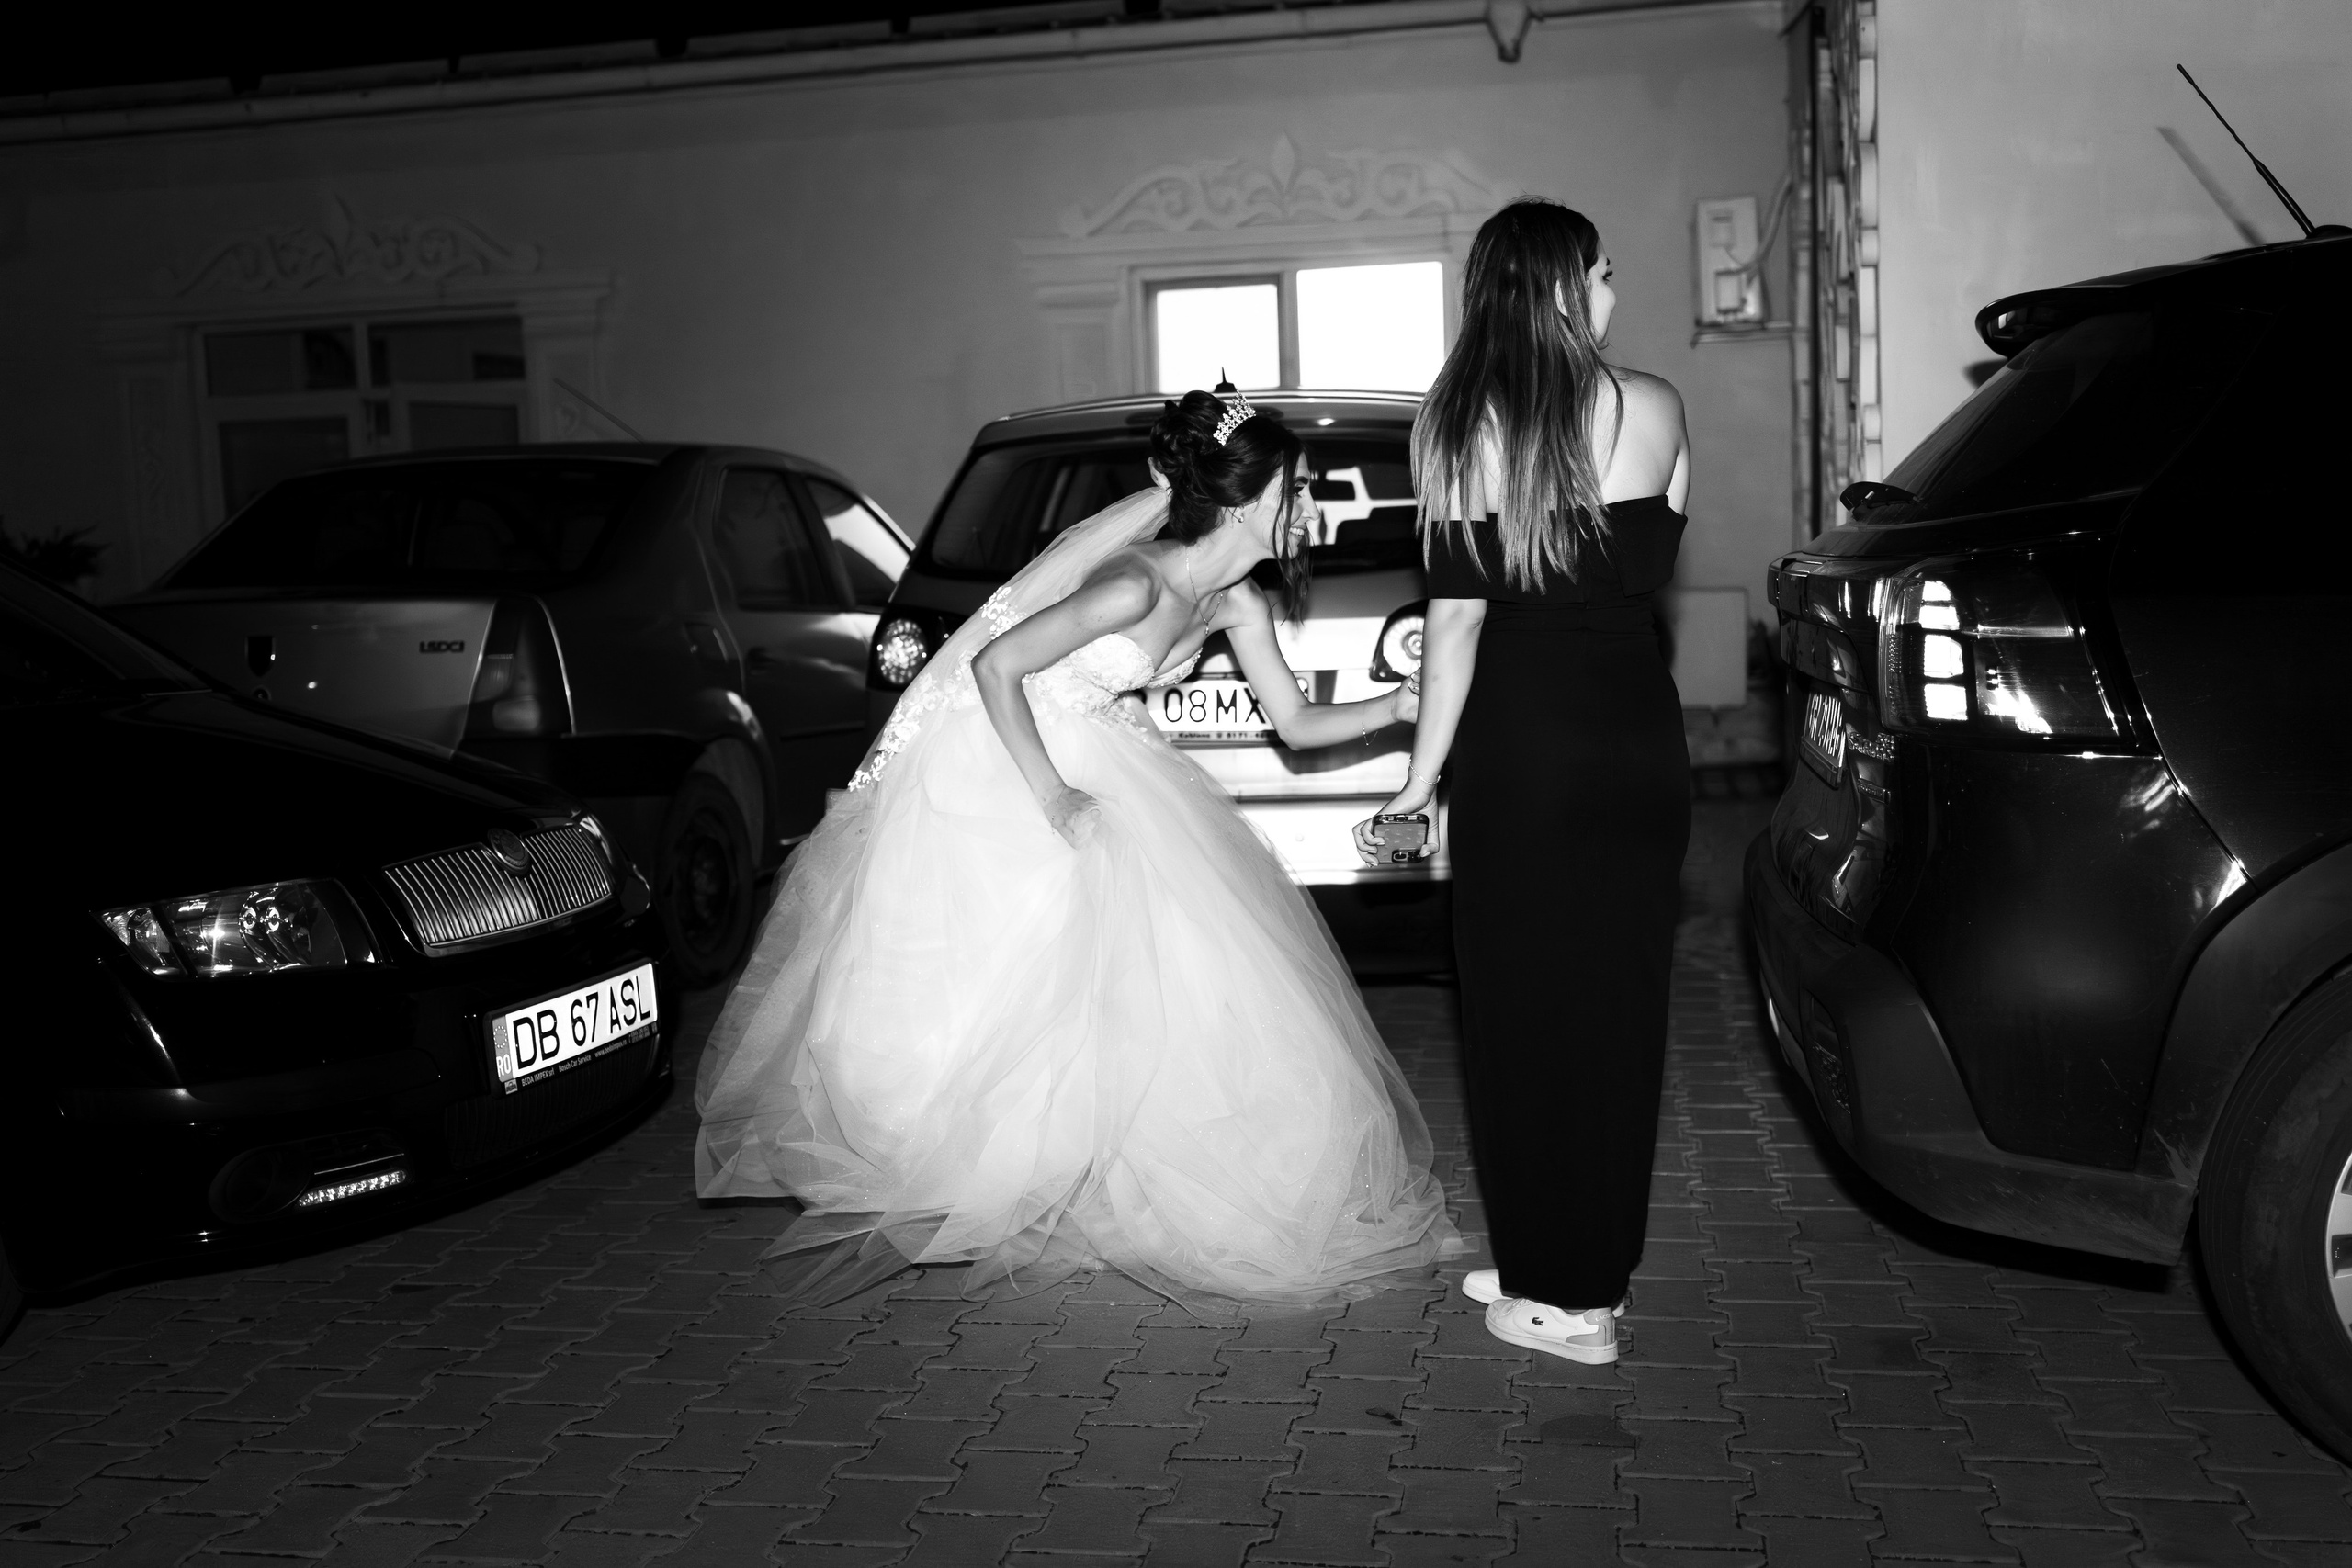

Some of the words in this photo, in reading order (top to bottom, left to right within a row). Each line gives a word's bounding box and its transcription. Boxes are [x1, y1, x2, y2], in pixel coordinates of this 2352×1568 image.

[513, 1009, 560, 1070] DB
[571, 991, 599, 1047] 67
[609, 976, 650, 1034] ASL
[495, 1054, 512, 1077] RO
[559, 1062, 571, 1073] Bosch
[578, 1054, 592, 1066] Service
